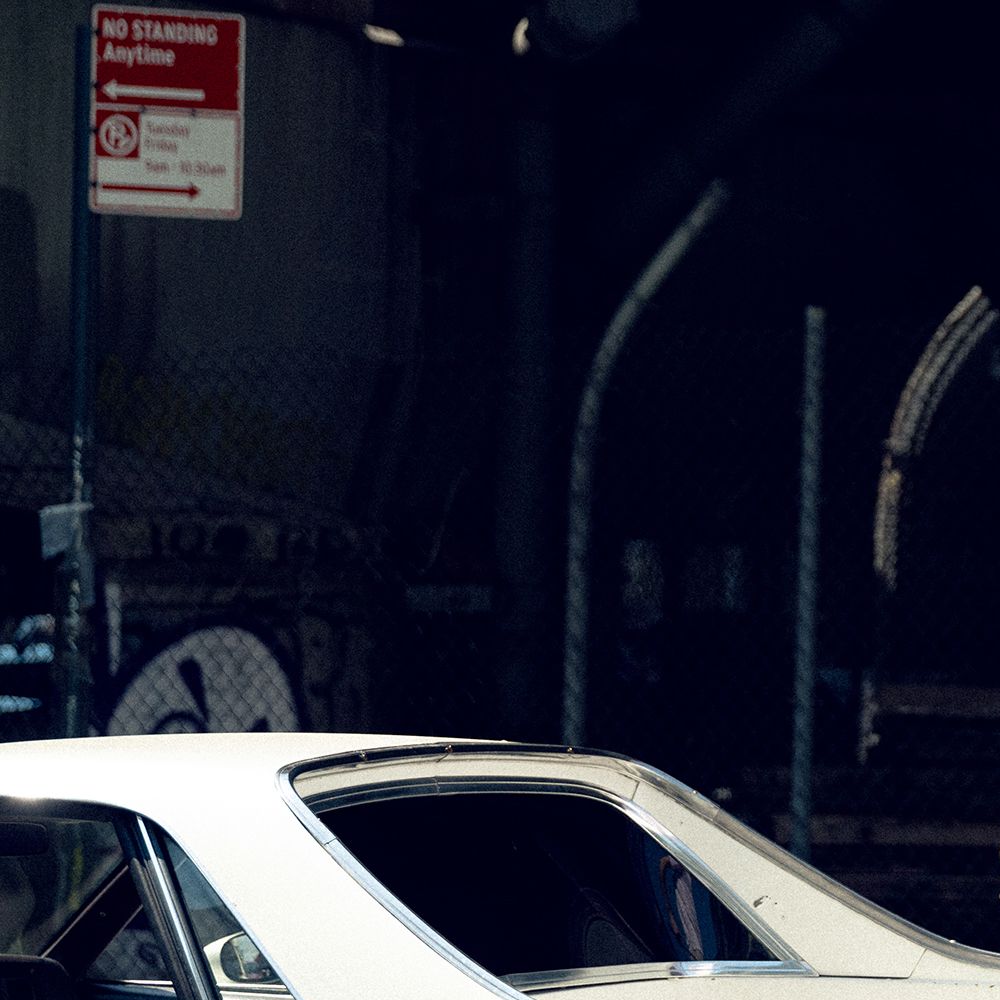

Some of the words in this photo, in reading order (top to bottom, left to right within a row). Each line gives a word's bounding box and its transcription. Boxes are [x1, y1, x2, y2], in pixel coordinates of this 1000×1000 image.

[102, 17, 128, 40] NO
[132, 20, 218, 46] STANDING
[102, 42, 176, 67] Anytime
